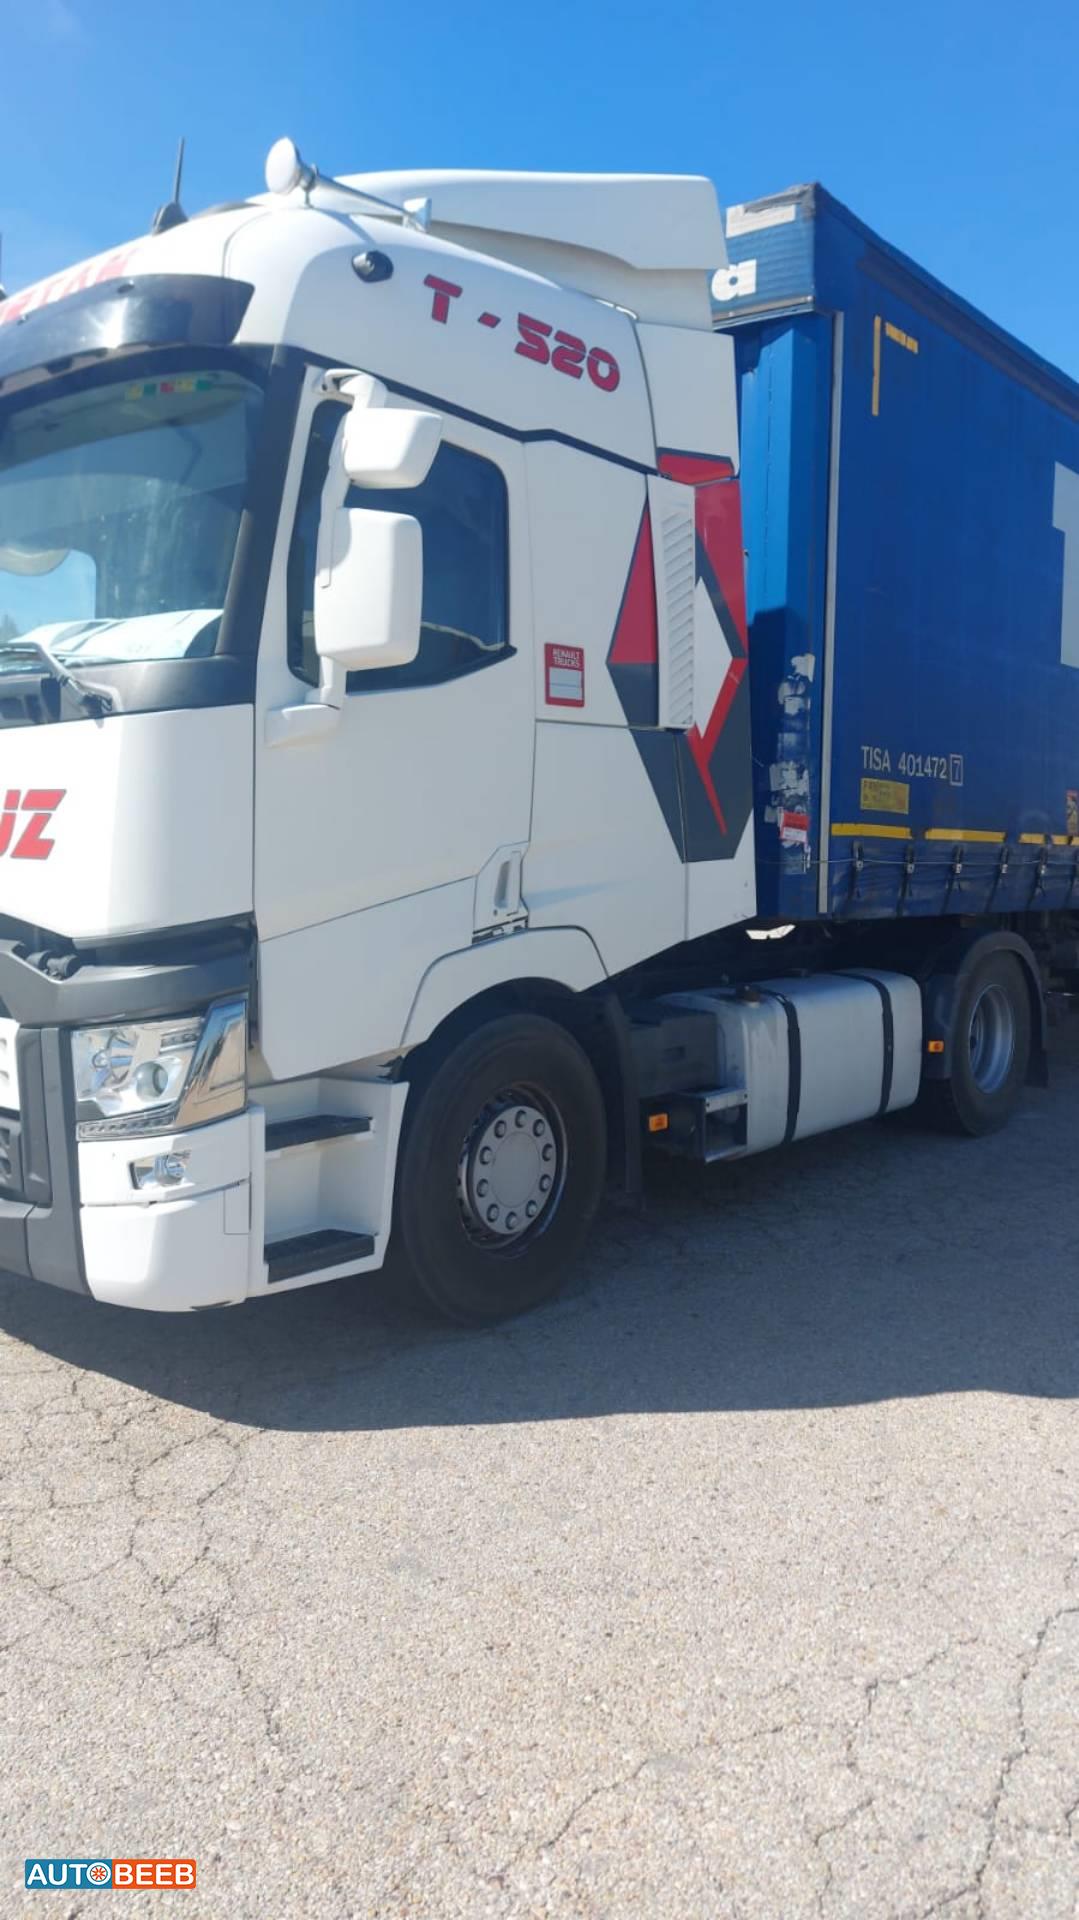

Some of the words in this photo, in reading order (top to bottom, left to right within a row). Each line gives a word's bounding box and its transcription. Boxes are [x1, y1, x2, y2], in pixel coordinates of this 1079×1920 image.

[424, 274, 463, 325] T
[514, 312, 621, 393] 520
[552, 648, 580, 659] RENAULT
[553, 657, 580, 667] TRUCKS
[861, 745, 892, 773] TISA
[898, 751, 948, 780] 401472
